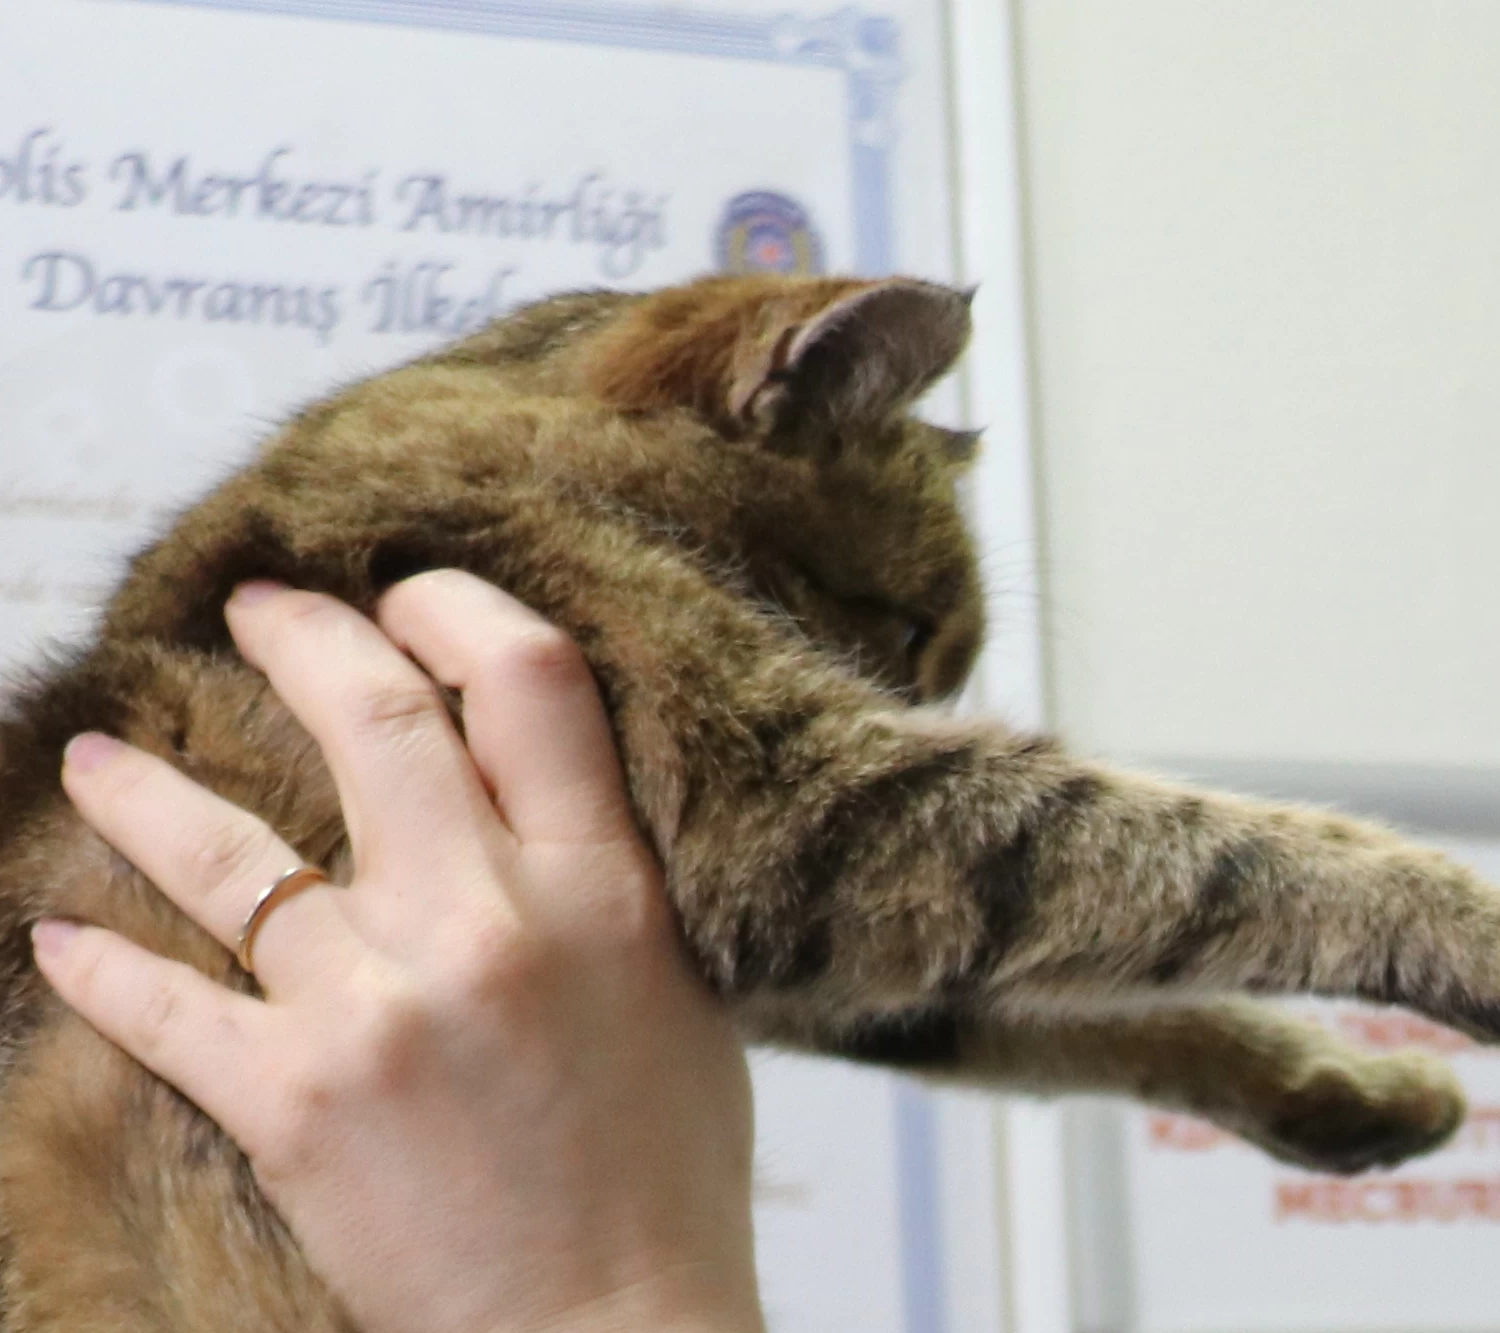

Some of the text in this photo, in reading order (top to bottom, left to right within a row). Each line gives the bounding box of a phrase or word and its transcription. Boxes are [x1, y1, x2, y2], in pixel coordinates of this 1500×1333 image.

[109, 144, 375, 230] Merkezi
[394, 166, 678, 279] Amirliği
[21, 247, 342, 346] Davranış
